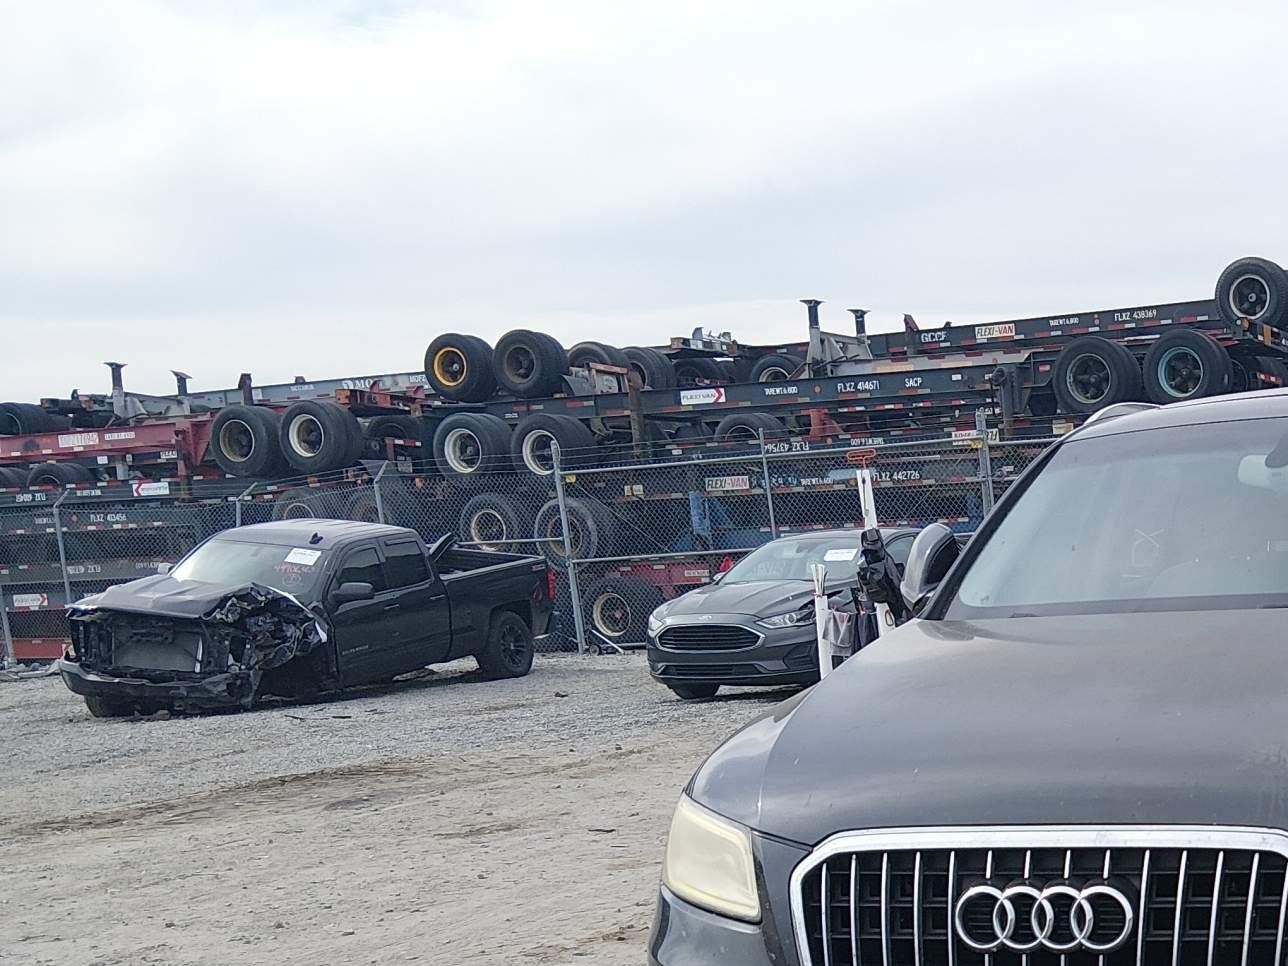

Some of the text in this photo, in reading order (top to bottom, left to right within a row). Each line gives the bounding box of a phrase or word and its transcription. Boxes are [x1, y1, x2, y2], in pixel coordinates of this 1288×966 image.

[1114, 309, 1157, 321] FLXZ 438369
[976, 324, 1014, 337] FLEXI-VAN
[837, 380, 880, 392] FLXZ 414671
[904, 377, 922, 387] SACP
[792, 441, 809, 451] FLXZ
[873, 470, 920, 481] FLXZ 442726
[706, 477, 748, 489] FLEXI-VAN
